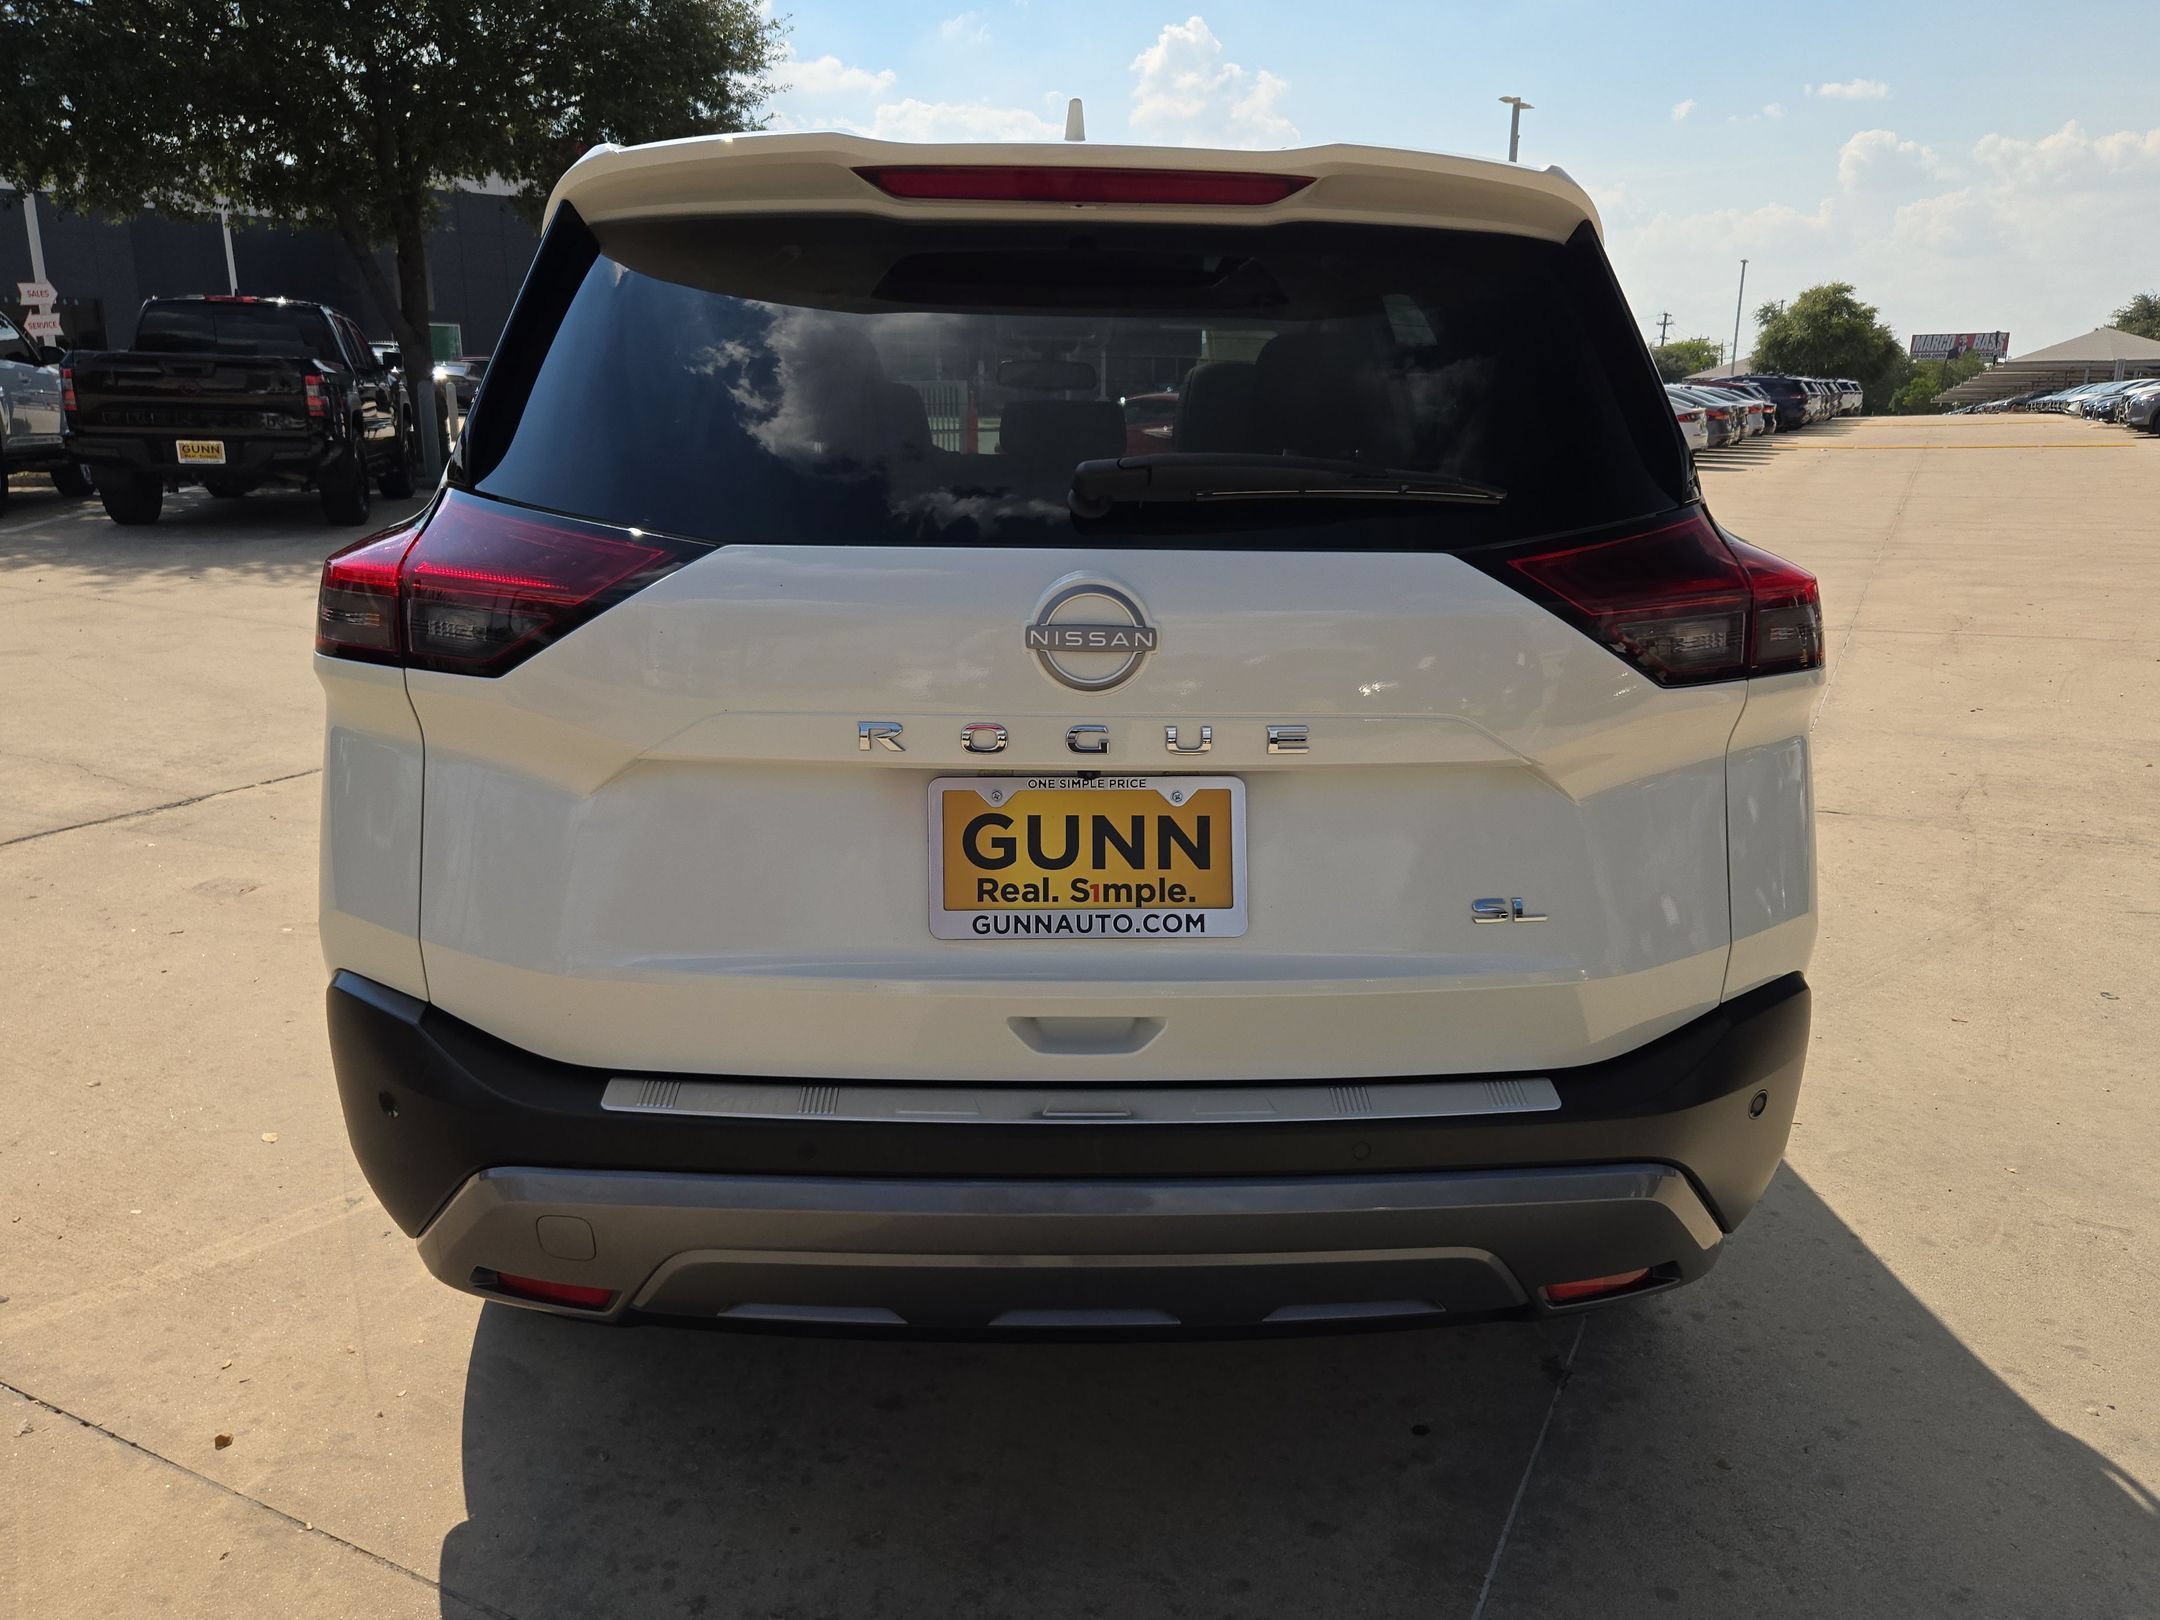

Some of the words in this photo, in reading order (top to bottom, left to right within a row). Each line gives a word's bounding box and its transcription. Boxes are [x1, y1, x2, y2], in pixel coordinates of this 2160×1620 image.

[27, 290, 49, 298] SALES
[28, 320, 57, 330] SERVICE
[1913, 335, 1956, 351] MARCO
[182, 445, 220, 454] GUNN
[1029, 629, 1154, 648] NISSAN
[857, 720, 1310, 755] ROGUE
[1027, 779, 1056, 789] ONE
[1059, 779, 1105, 789] SIMPLE
[1109, 778, 1147, 789] PRICE
[962, 812, 1211, 871] GUNN
[977, 877, 1059, 903] Real.
[1472, 897, 1549, 924] SL
[972, 913, 1206, 935] GUNNAUTO.COM
